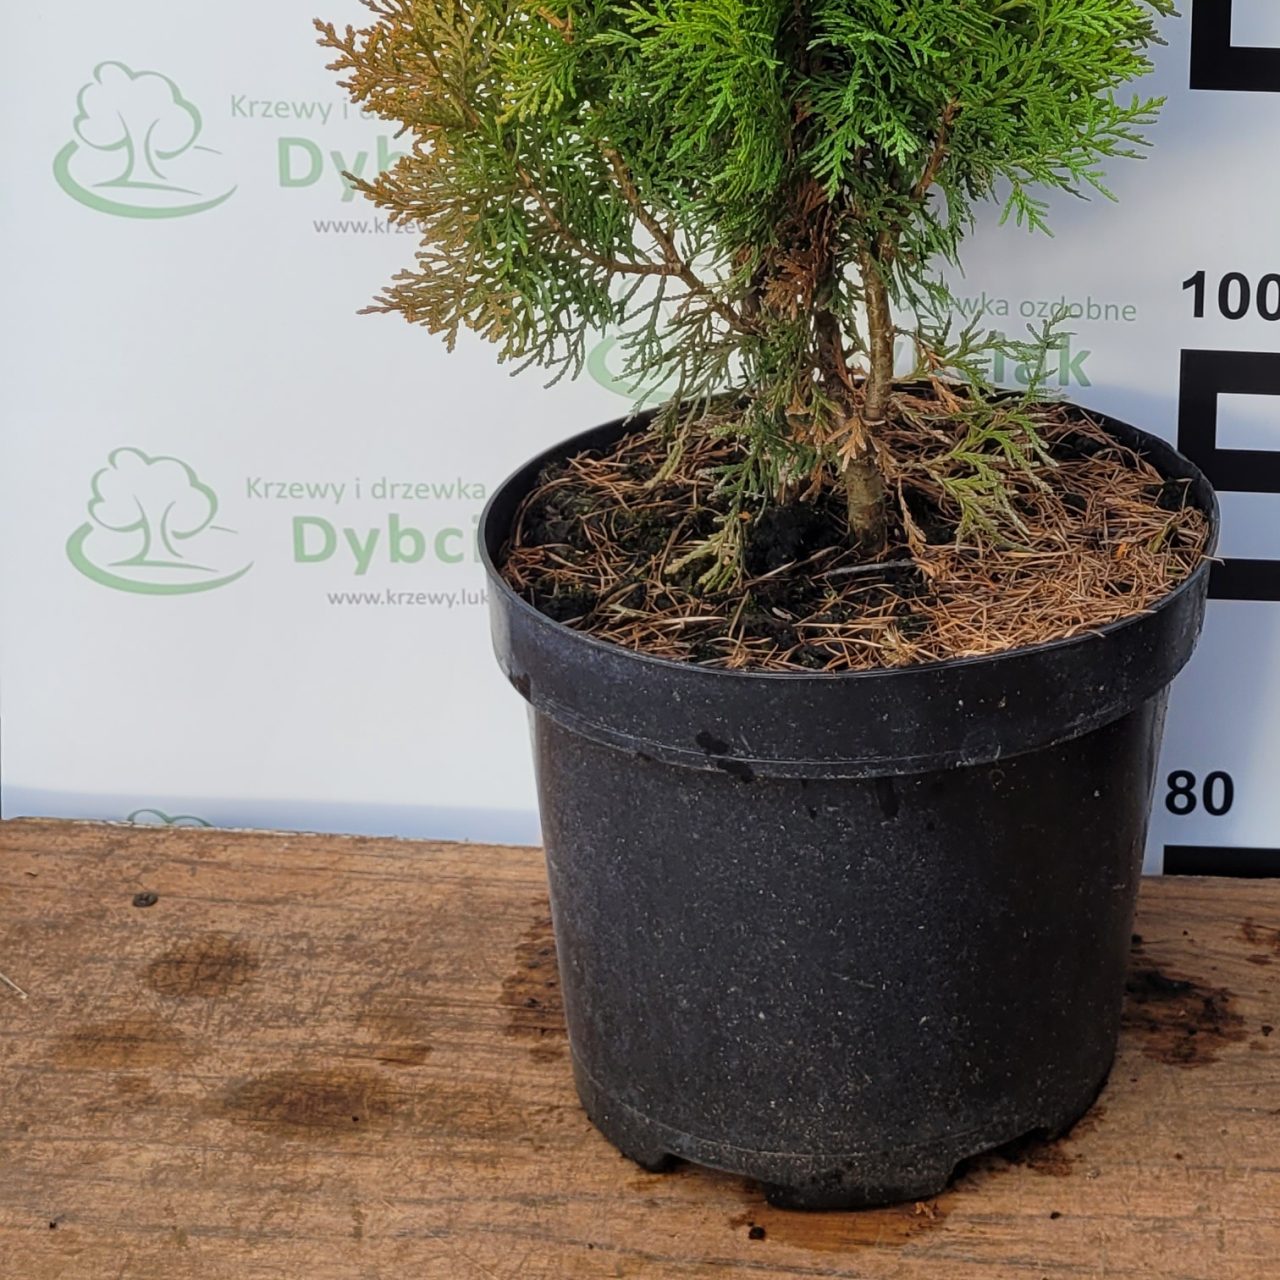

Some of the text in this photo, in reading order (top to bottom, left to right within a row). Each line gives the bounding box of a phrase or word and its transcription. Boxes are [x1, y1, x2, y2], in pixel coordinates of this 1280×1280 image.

[231, 95, 332, 124] Krzewy
[342, 97, 349, 120] i
[1020, 296, 1137, 321] ozdobne
[246, 477, 486, 504] Krzewy i drzewka
[1164, 770, 1234, 816] 80
